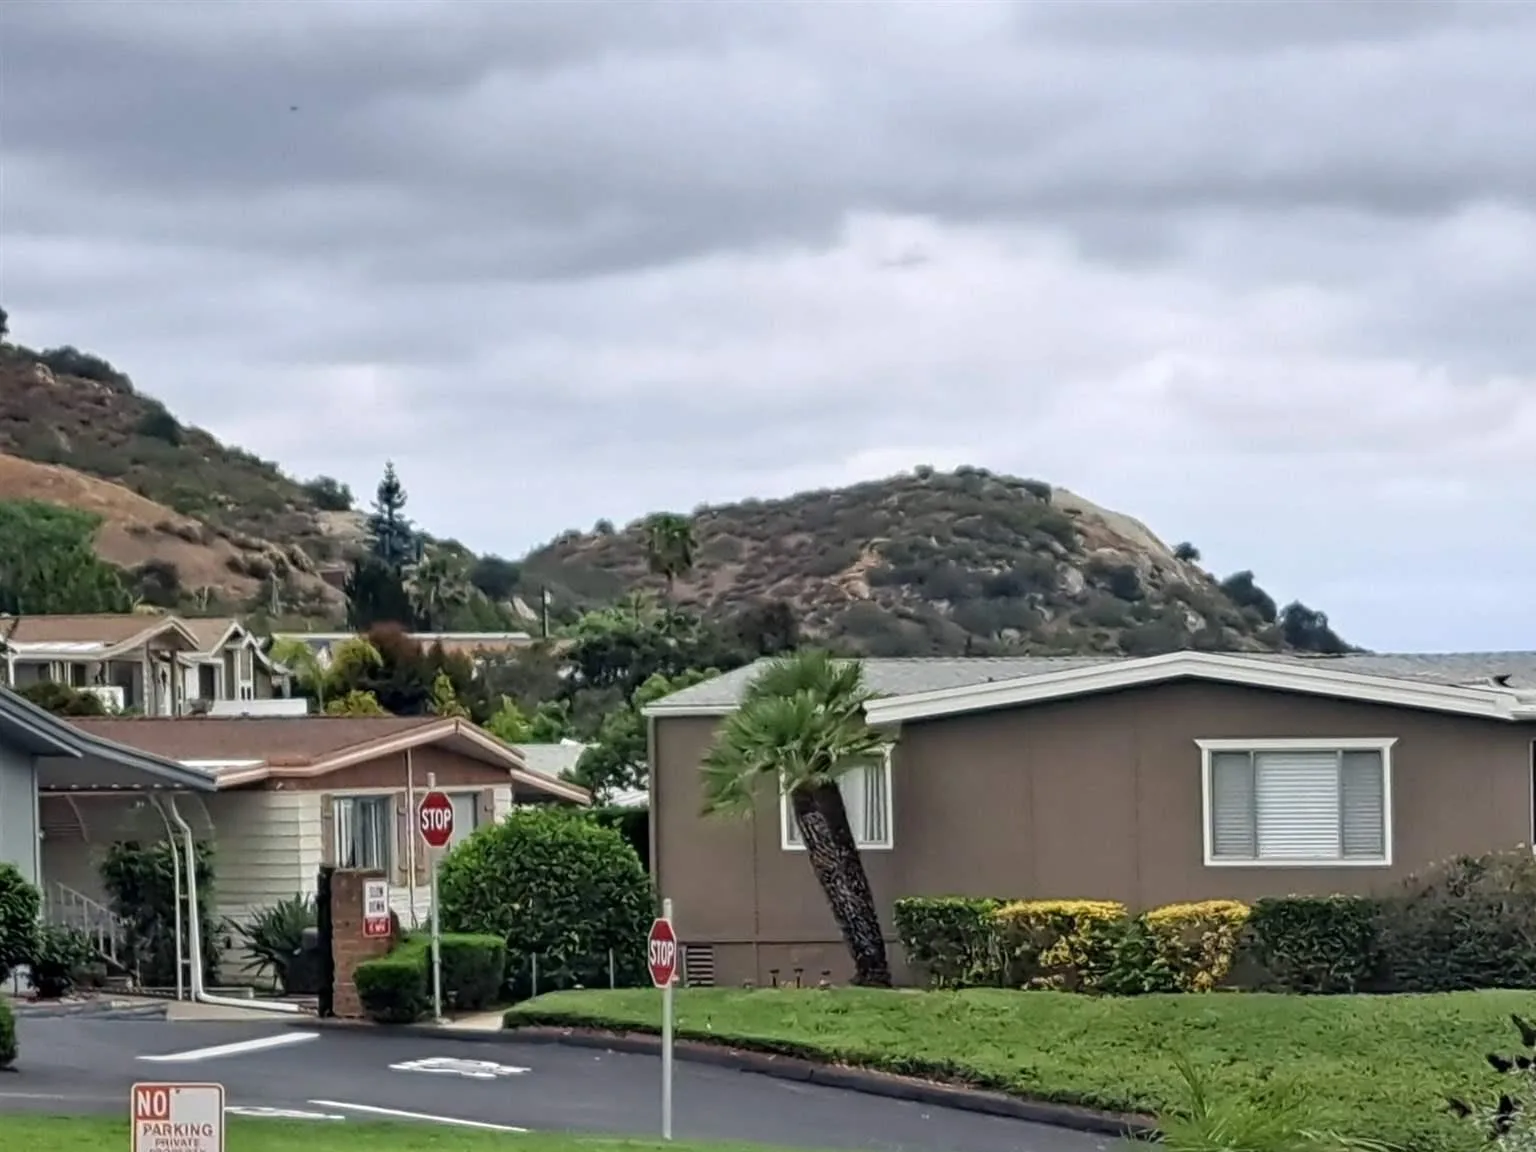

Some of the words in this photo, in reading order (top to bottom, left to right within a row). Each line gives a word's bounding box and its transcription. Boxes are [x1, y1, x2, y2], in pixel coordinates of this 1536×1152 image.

[421, 808, 452, 830] STOP
[650, 940, 674, 966] STOP
[137, 1090, 167, 1117] NO
[143, 1123, 213, 1137] PARKING
[155, 1138, 199, 1147] PRIVATE
